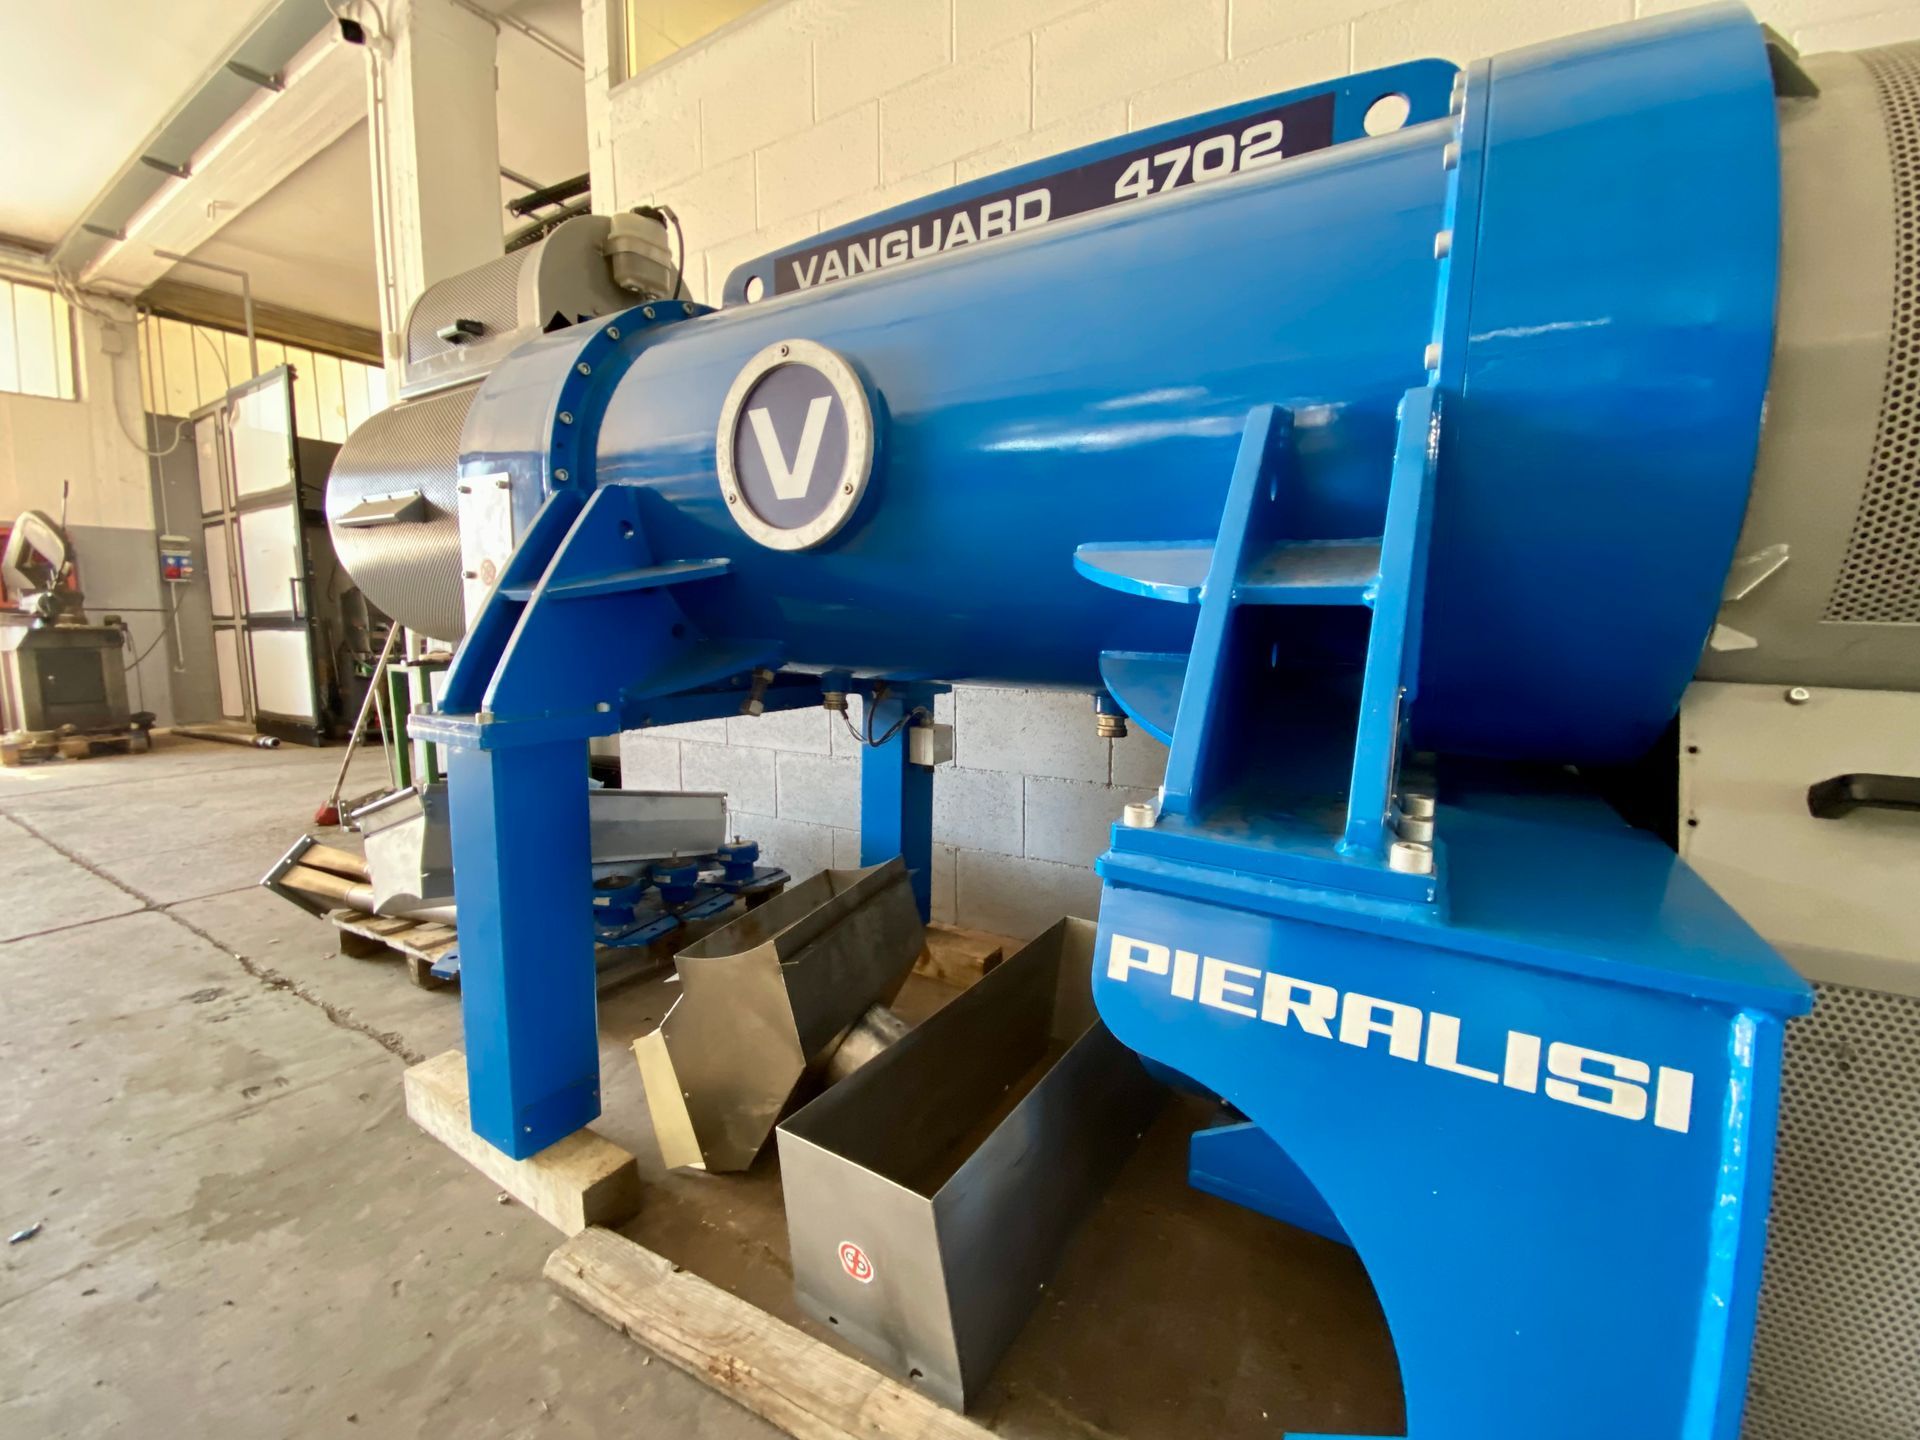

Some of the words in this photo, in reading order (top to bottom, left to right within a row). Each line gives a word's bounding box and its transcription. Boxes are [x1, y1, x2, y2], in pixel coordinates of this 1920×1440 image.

[791, 188, 1051, 290] VANGUARD
[1114, 119, 1284, 199] 4702
[747, 395, 833, 500] V
[1107, 933, 1694, 1134] PIERALISI
